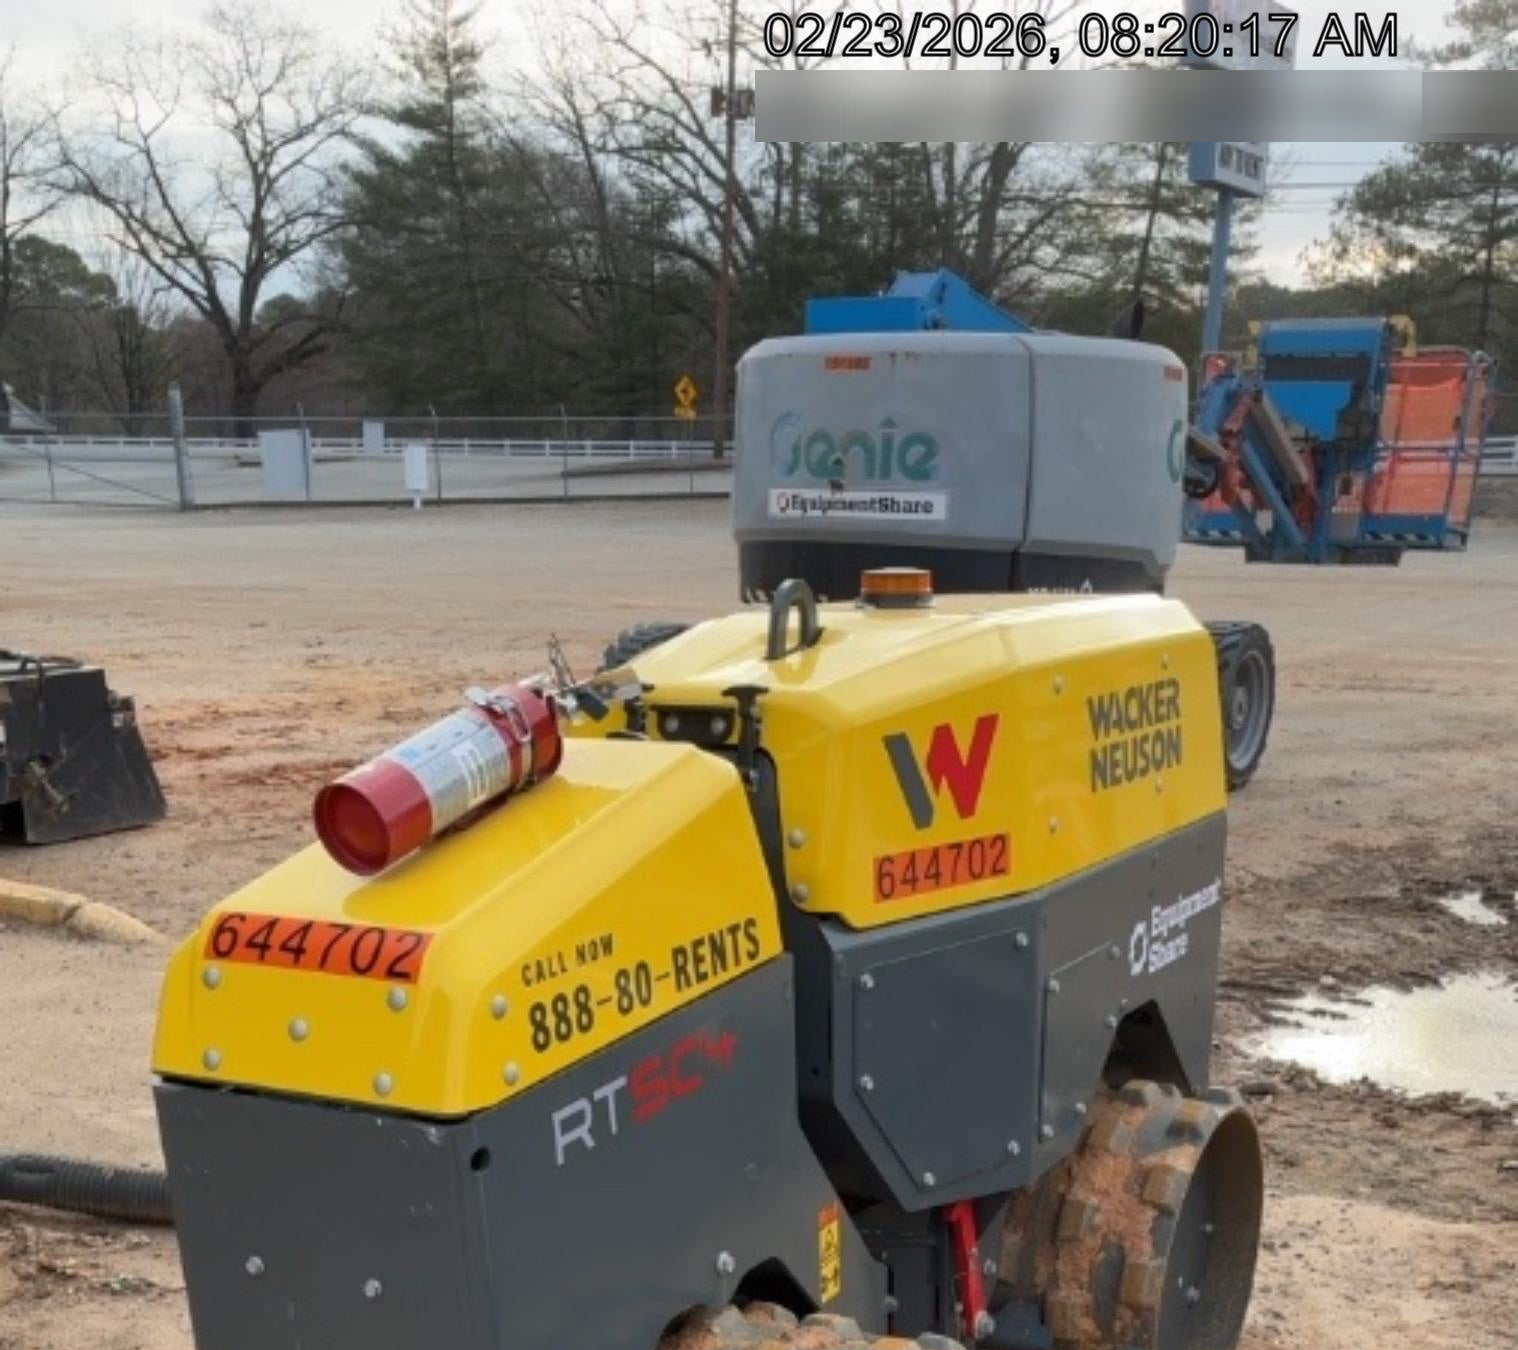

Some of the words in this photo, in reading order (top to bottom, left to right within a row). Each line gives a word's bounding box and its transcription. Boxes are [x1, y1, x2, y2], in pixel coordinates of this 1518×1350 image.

[771, 411, 940, 481] Genie
[790, 494, 935, 515] EquipmentShare
[1086, 677, 1181, 742] WACKER
[1089, 724, 1182, 793] NEUSON
[878, 834, 1007, 899] 644702
[1150, 877, 1221, 937] Equipment
[212, 911, 424, 980] 644702
[521, 951, 568, 987] CALL
[575, 933, 614, 966] NOW
[1148, 932, 1189, 973] Share
[529, 917, 760, 1053] 888-80-RENTS
